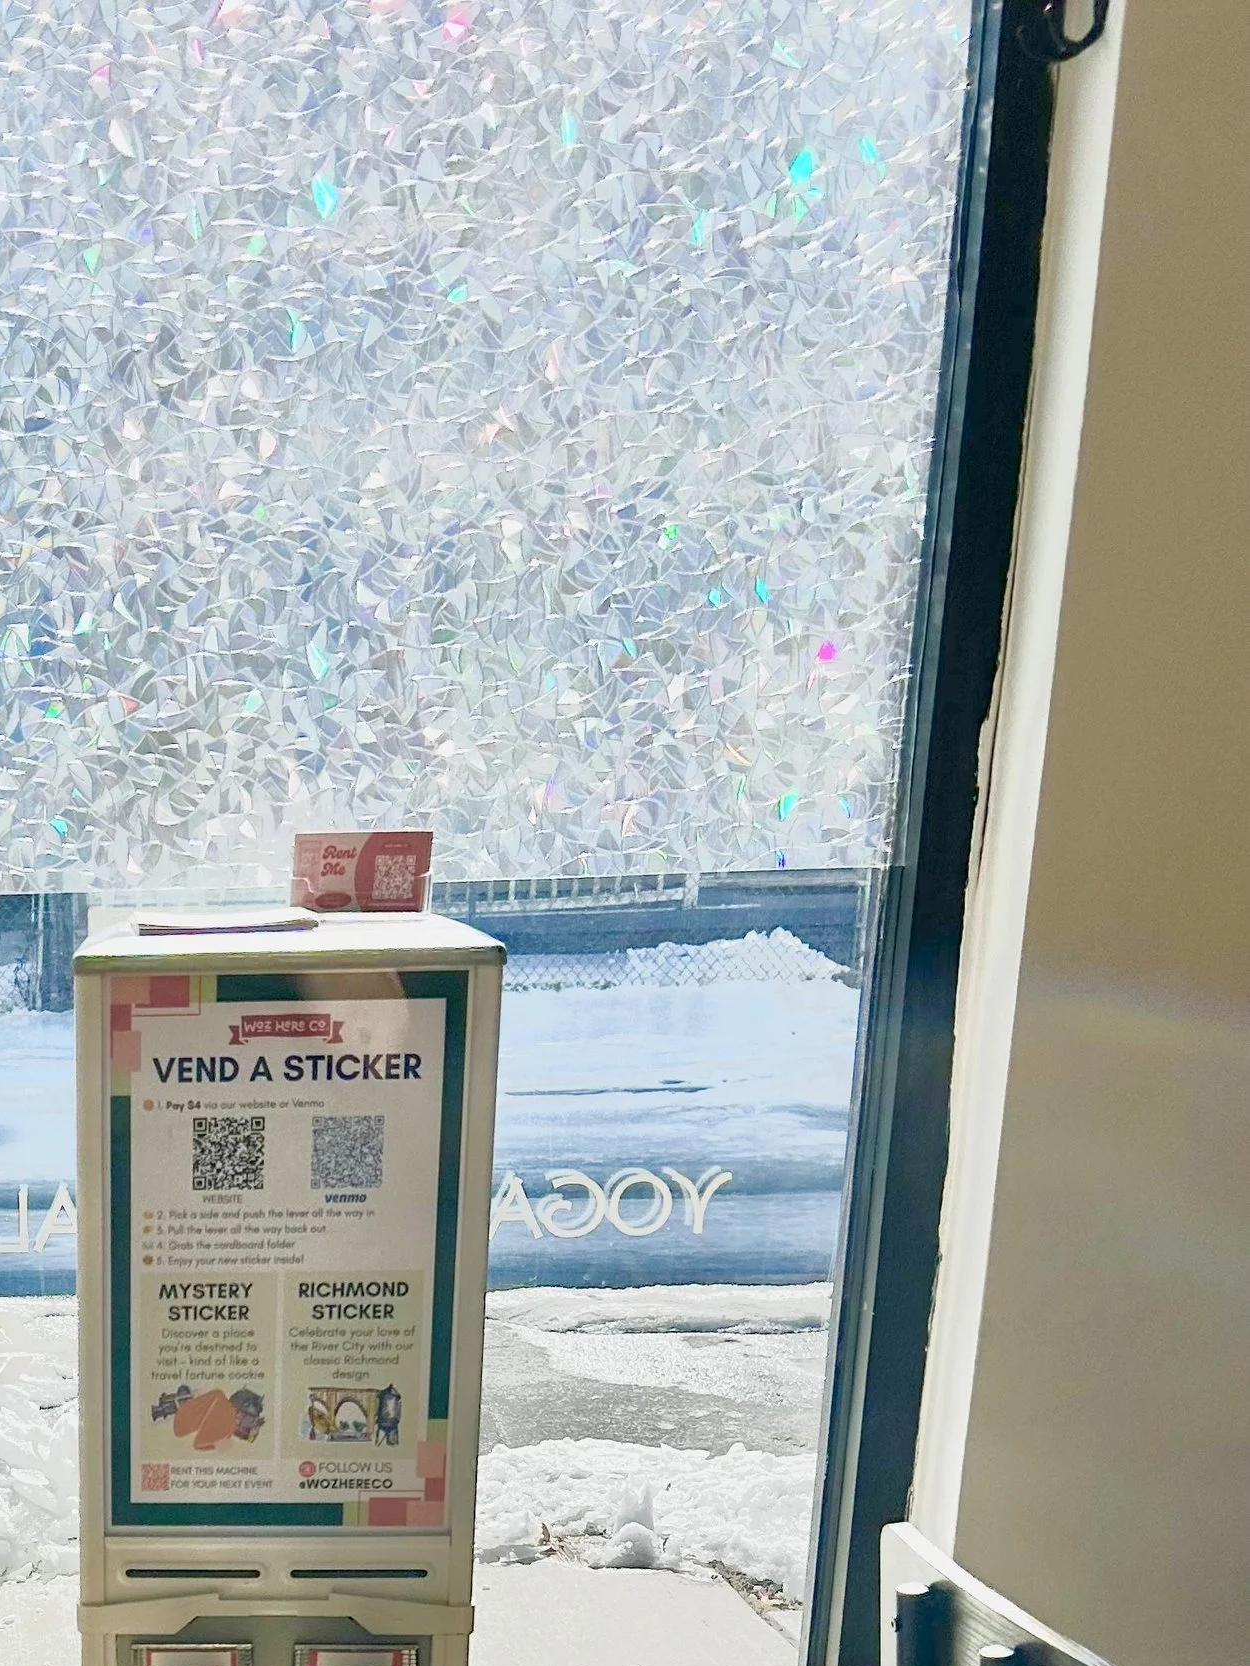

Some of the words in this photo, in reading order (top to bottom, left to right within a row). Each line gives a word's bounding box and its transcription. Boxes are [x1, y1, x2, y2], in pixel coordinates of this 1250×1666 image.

[322, 844, 357, 859] Rent
[321, 862, 346, 877] Me
[153, 1056, 239, 1083] VEND
[250, 1056, 273, 1082] A
[284, 1053, 422, 1082] STICKER
[166, 1101, 184, 1112] Pay
[187, 1100, 201, 1110] $4
[203, 1101, 218, 1109] via
[220, 1101, 236, 1109] our
[238, 1099, 276, 1109] website
[279, 1101, 289, 1109] or
[291, 1099, 325, 1108] Venmo
[202, 1194, 243, 1204] WEBSITE
[324, 1193, 367, 1204] venmo
[156, 1210, 165, 1220] 2.
[168, 1209, 188, 1219] Pick
[191, 1211, 197, 1219] a
[199, 1209, 219, 1219] side
[221, 1209, 240, 1219] and
[242, 1209, 265, 1221] push
[268, 1208, 283, 1218] the
[286, 1208, 309, 1218] lever
[311, 1207, 323, 1217] all
[326, 1207, 342, 1217] the
[344, 1210, 363, 1219] way
[366, 1208, 375, 1217] in
[167, 1224, 184, 1235] Pull
[187, 1225, 202, 1234] the
[204, 1225, 228, 1234] lever
[230, 1224, 242, 1234] all
[244, 1225, 260, 1234] the
[262, 1226, 282, 1236] way
[284, 1224, 307, 1233] back
[310, 1224, 326, 1233] out
[168, 1239, 194, 1250] Grab
[196, 1240, 211, 1249] the
[213, 1239, 264, 1249] cardboard
[267, 1239, 295, 1249] folder
[168, 1255, 193, 1268] Enjoy
[195, 1257, 215, 1268] your
[217, 1257, 238, 1265] new
[240, 1254, 271, 1264] sticker
[273, 1254, 304, 1264] inside!
[159, 1282, 253, 1299] MYSTERY
[299, 1281, 409, 1298] RICHMOND
[168, 1305, 250, 1321] STICKER
[312, 1304, 394, 1320] STICKER
[161, 1328, 209, 1339] Discover
[212, 1330, 219, 1339] a
[222, 1326, 255, 1340] place
[288, 1326, 347, 1338] Celebrate
[349, 1329, 372, 1340] your
[376, 1326, 400, 1337] love
[403, 1325, 416, 1337] of
[158, 1343, 191, 1356] you're
[194, 1341, 242, 1353] destined
[246, 1342, 257, 1352] to
[290, 1341, 309, 1351] the
[312, 1341, 339, 1351] River
[342, 1340, 365, 1354] City
[368, 1339, 392, 1351] with
[395, 1342, 414, 1351] our
[157, 1356, 177, 1366] visit
[189, 1355, 211, 1366] kind
[215, 1355, 227, 1366] of
[229, 1354, 248, 1366] like
[251, 1357, 259, 1366] a
[303, 1353, 340, 1366] classic
[344, 1353, 399, 1366] Richmond
[151, 1369, 182, 1381] travel
[185, 1369, 224, 1380] fortune
[228, 1369, 265, 1380] cookie
[332, 1368, 370, 1381] design
[170, 1466, 192, 1475] RENT
[195, 1466, 214, 1475] THIS
[216, 1466, 258, 1475] MACHINE
[318, 1462, 372, 1473] FOLLOW
[375, 1462, 393, 1473] US
[170, 1480, 190, 1489] FOR
[193, 1480, 217, 1489] YOUR
[219, 1480, 242, 1489] NEXT
[245, 1480, 273, 1489] EVENT
[299, 1478, 393, 1489] @WOZHERECO
